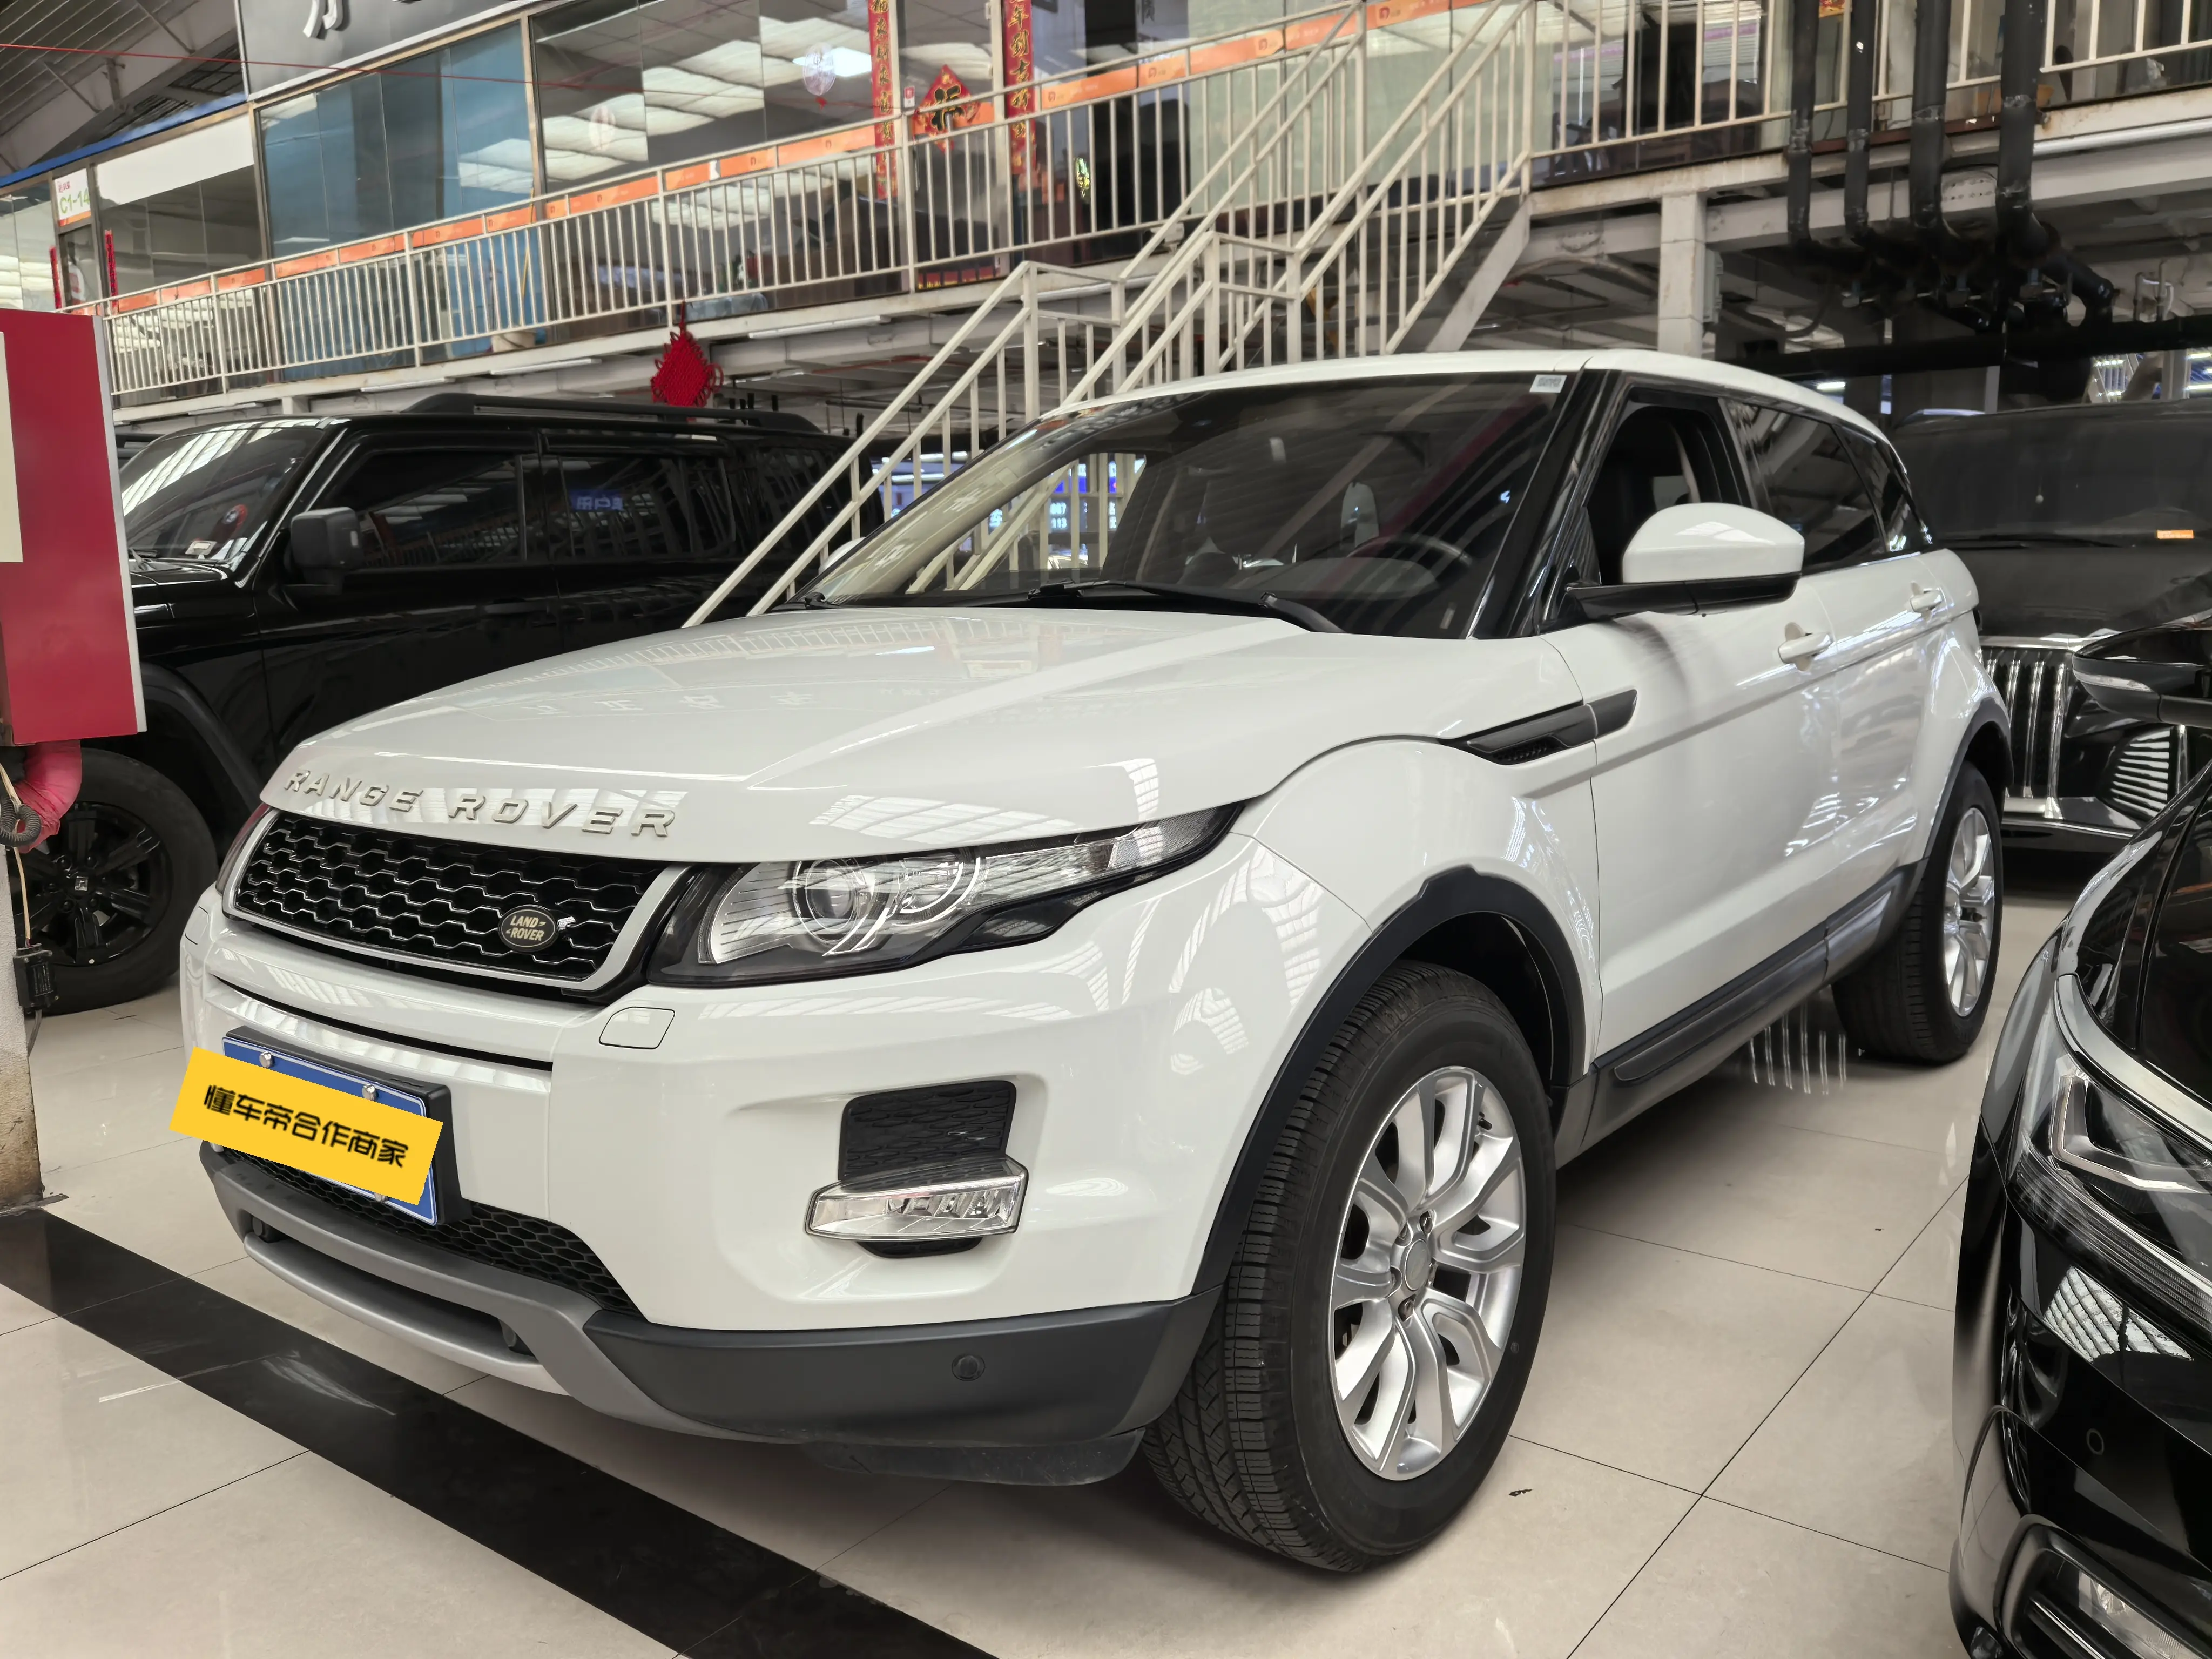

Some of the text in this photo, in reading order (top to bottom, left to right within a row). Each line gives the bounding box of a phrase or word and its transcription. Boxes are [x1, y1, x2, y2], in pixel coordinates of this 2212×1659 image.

[284, 770, 675, 838] RANGE ROVER
[510, 915, 539, 928] LAND
[510, 927, 544, 941] ROVER
